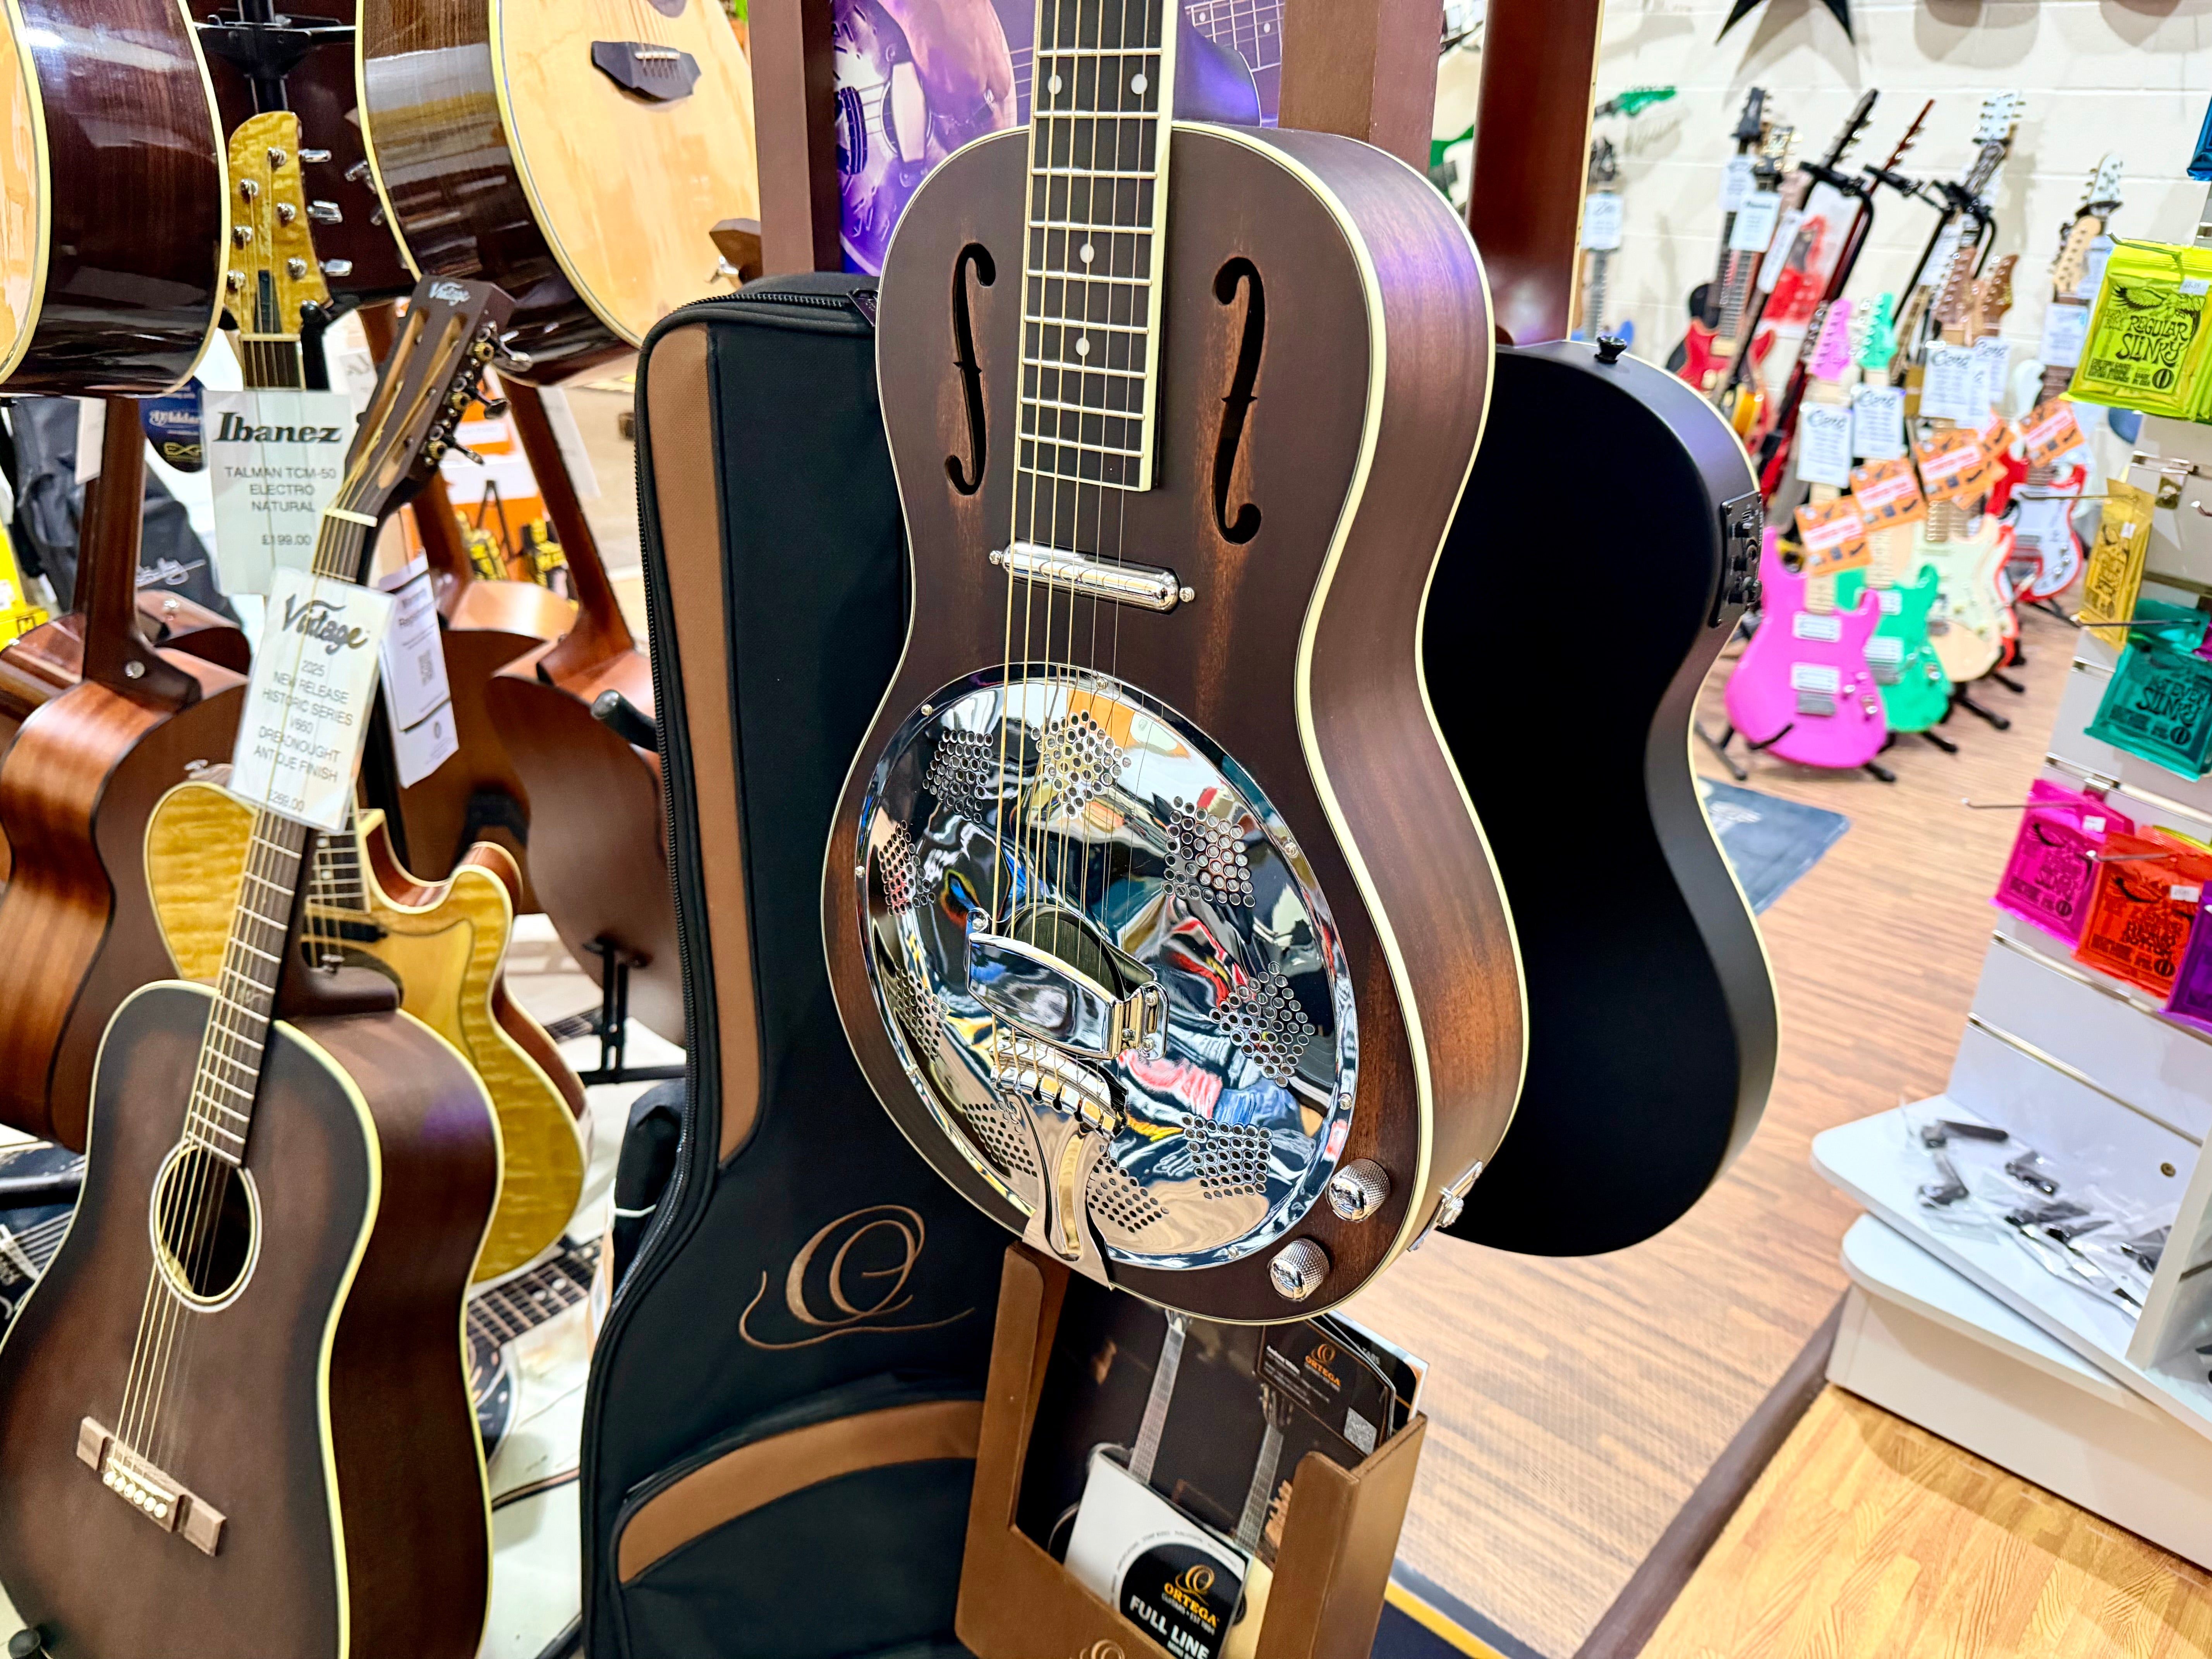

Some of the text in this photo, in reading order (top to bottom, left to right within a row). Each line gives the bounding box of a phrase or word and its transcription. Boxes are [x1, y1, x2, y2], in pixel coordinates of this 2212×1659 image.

[2127, 315, 2188, 342] REGULAR
[2116, 333, 2187, 368] SLINKY
[213, 411, 342, 443] Ibanez
[224, 466, 336, 479] TALMAN TCM-50
[250, 484, 315, 495] ELECTRO
[251, 501, 315, 512] NATURAL
[282, 593, 369, 655] Vintage
[262, 688, 353, 726] HISTORIC SERIES
[299, 679, 350, 705] RELEASE
[254, 745, 338, 783] ANTQUE FINISH
[1305, 1355, 1341, 1387] ORTEGA
[1164, 1582, 1217, 1628] ORTEGA
[1129, 1594, 1168, 1636] FULL
[1171, 1625, 1210, 1659] LINE
